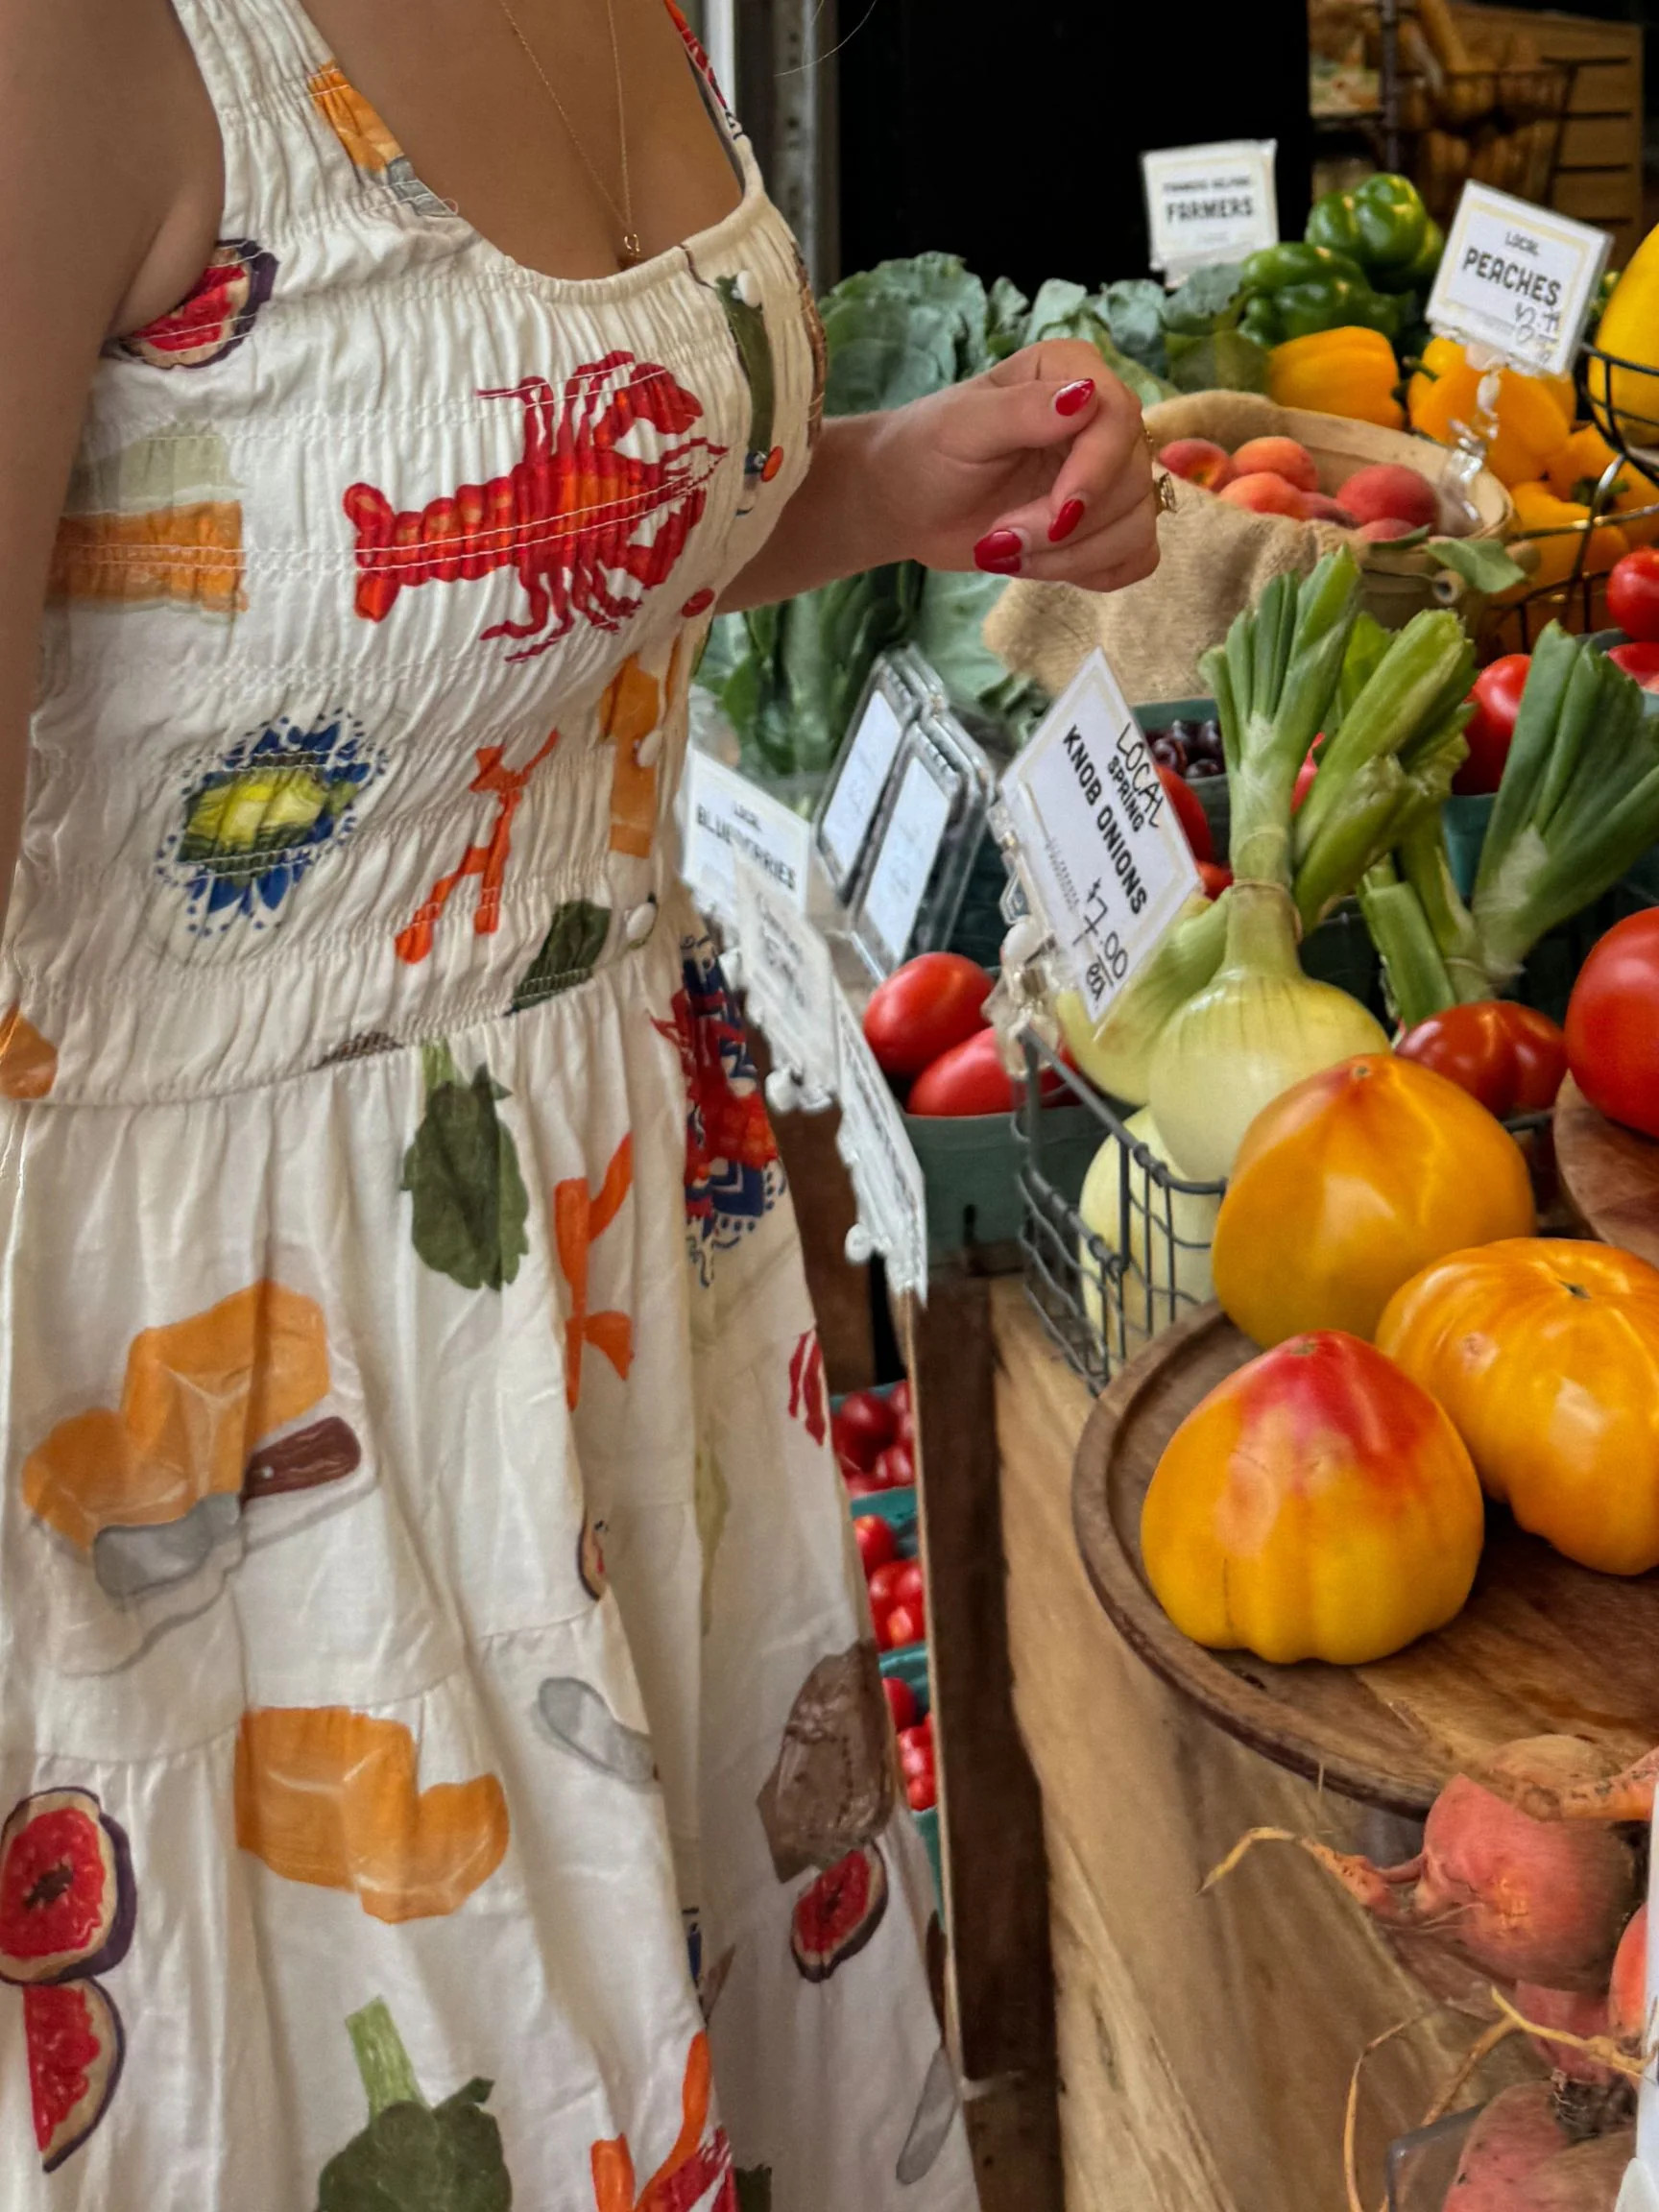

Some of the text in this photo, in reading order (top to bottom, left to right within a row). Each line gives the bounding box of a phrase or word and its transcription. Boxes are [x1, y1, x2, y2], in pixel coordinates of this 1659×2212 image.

[1166, 195, 1253, 223] FARMERS
[1462, 246, 1562, 306] PEACHES
[1063, 724, 1148, 915] KNOB ONIONS
[1108, 756, 1144, 832] SPRING
[1117, 723, 1164, 828] LOCAL
[1072, 877, 1128, 978] $7.00
